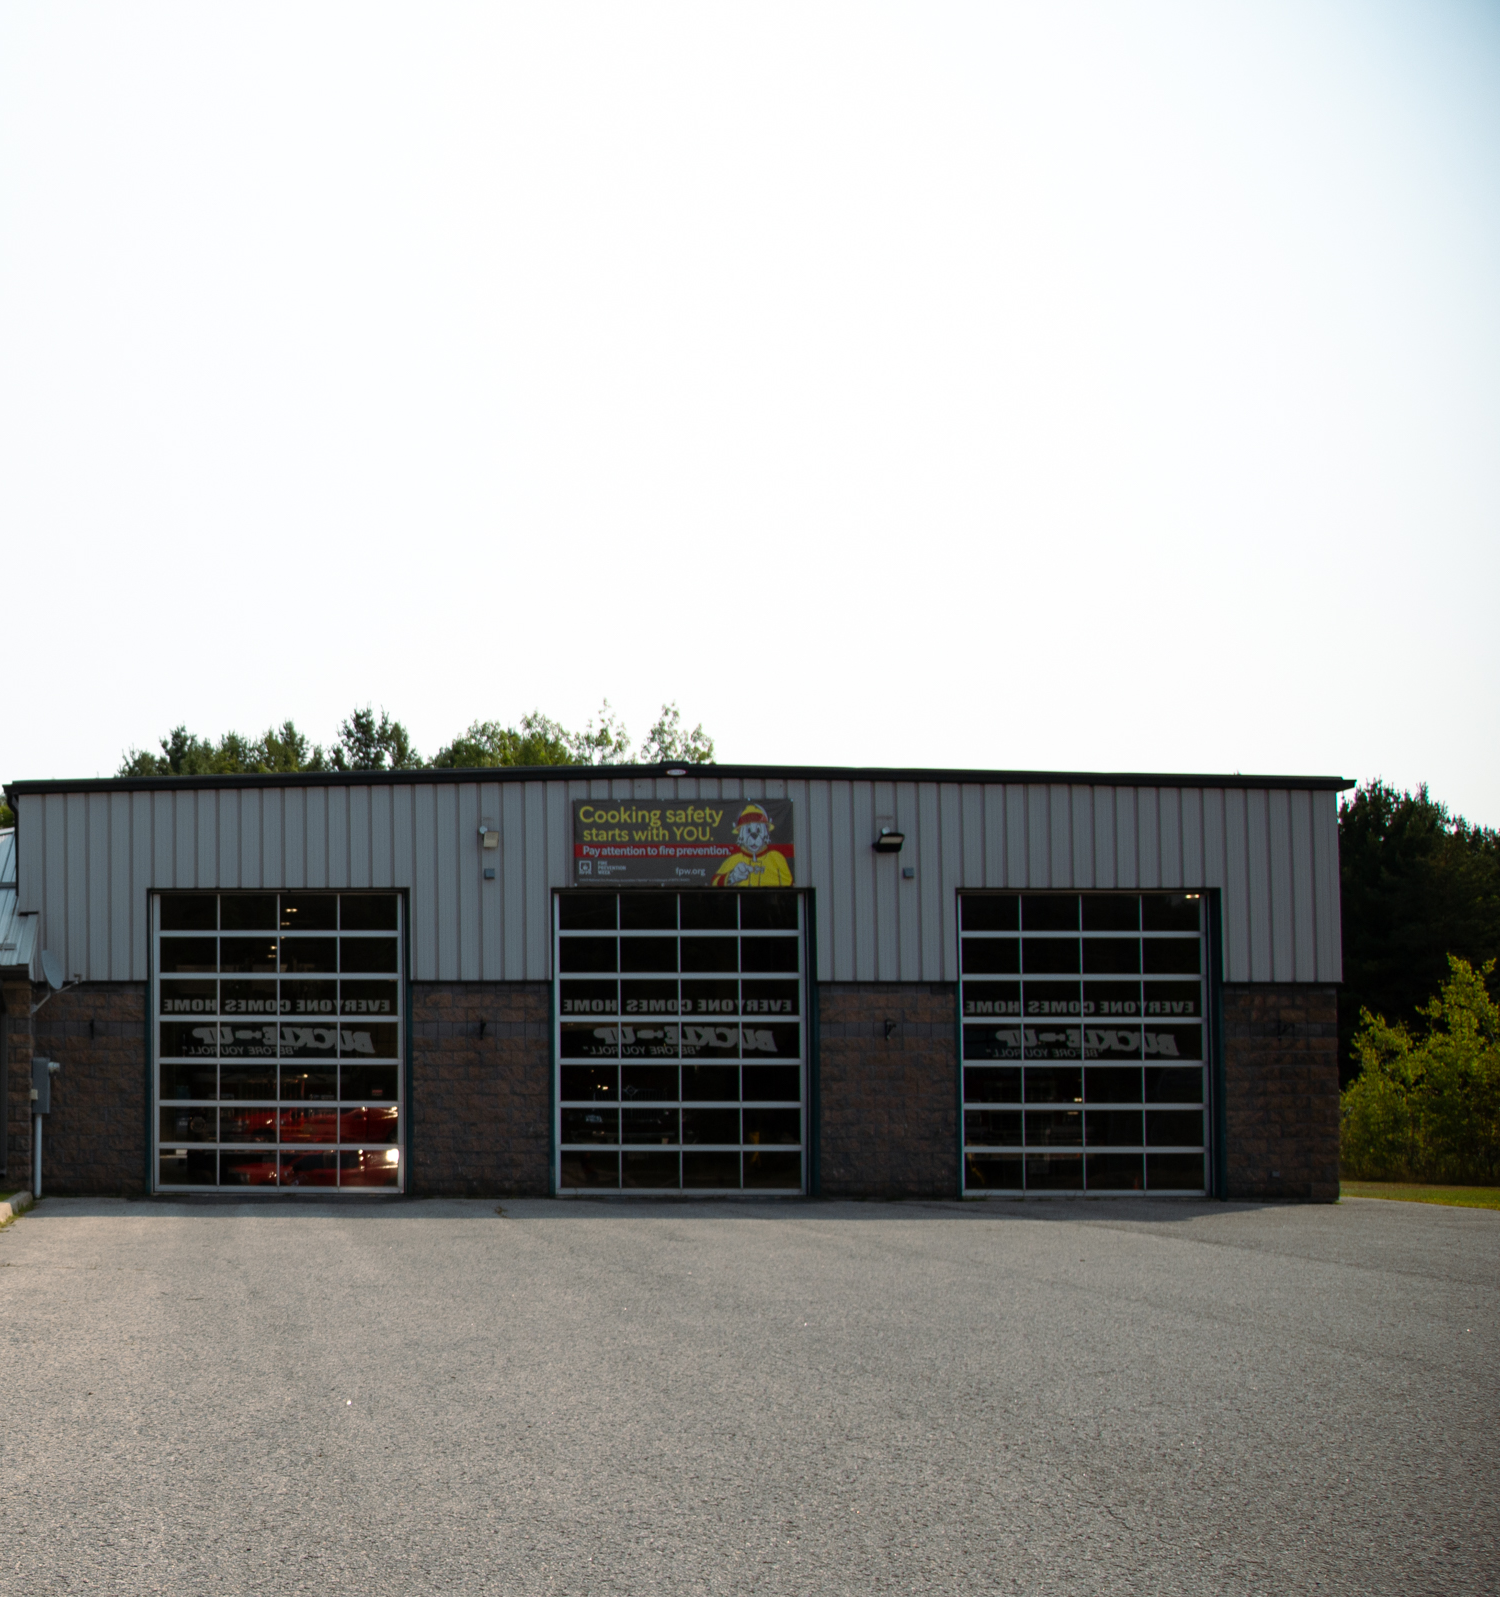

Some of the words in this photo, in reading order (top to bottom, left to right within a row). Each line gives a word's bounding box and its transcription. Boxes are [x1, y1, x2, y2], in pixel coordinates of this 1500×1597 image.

[579, 806, 661, 827] Cooking
[666, 806, 723, 827] safety
[583, 827, 629, 841] starts
[633, 827, 669, 841] with
[673, 826, 714, 841] YOU.
[583, 846, 601, 857] Pay
[602, 846, 646, 856] attention
[647, 846, 658, 856] to
[659, 846, 675, 856] fire
[675, 866, 706, 876] fpw.org
